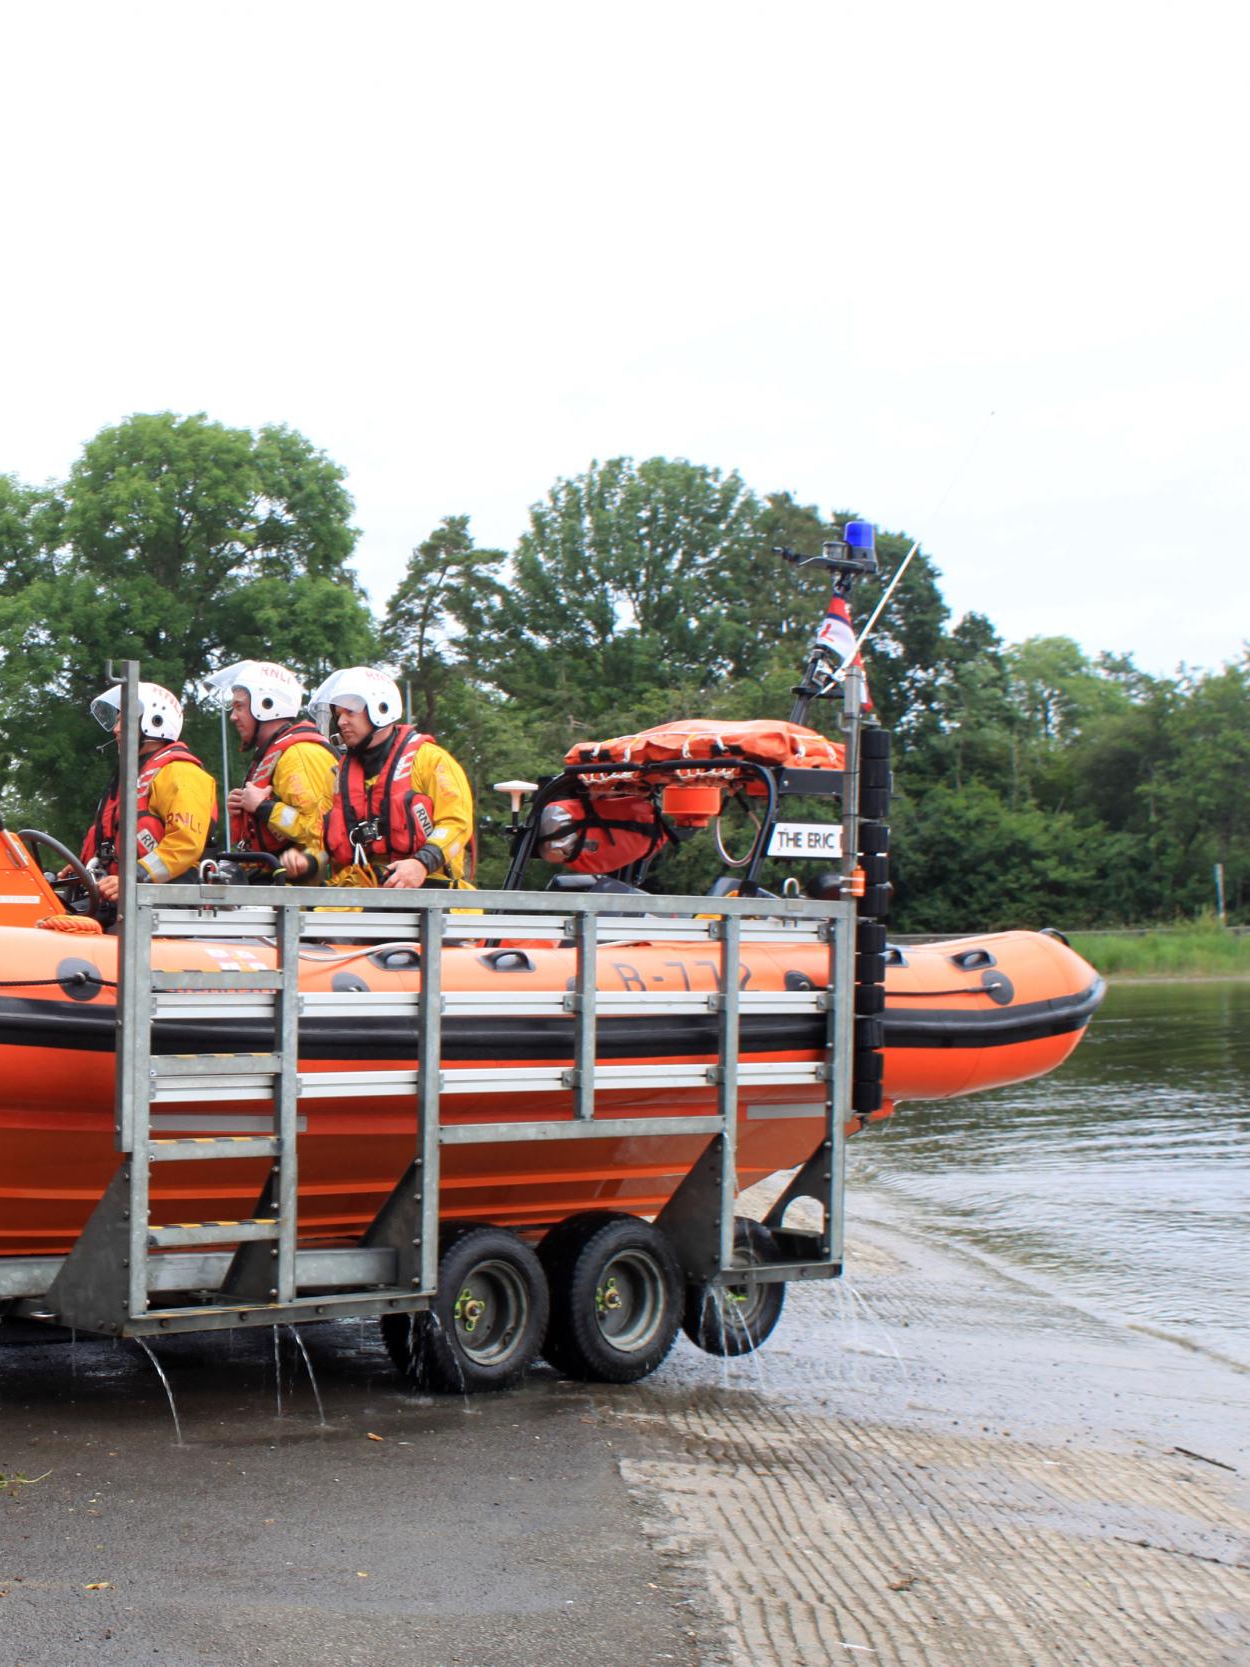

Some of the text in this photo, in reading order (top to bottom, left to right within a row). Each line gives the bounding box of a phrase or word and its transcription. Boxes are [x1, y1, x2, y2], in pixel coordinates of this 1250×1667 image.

[261, 666, 291, 685] RNLI
[777, 831, 802, 848] THE
[807, 832, 835, 849] ERIC
